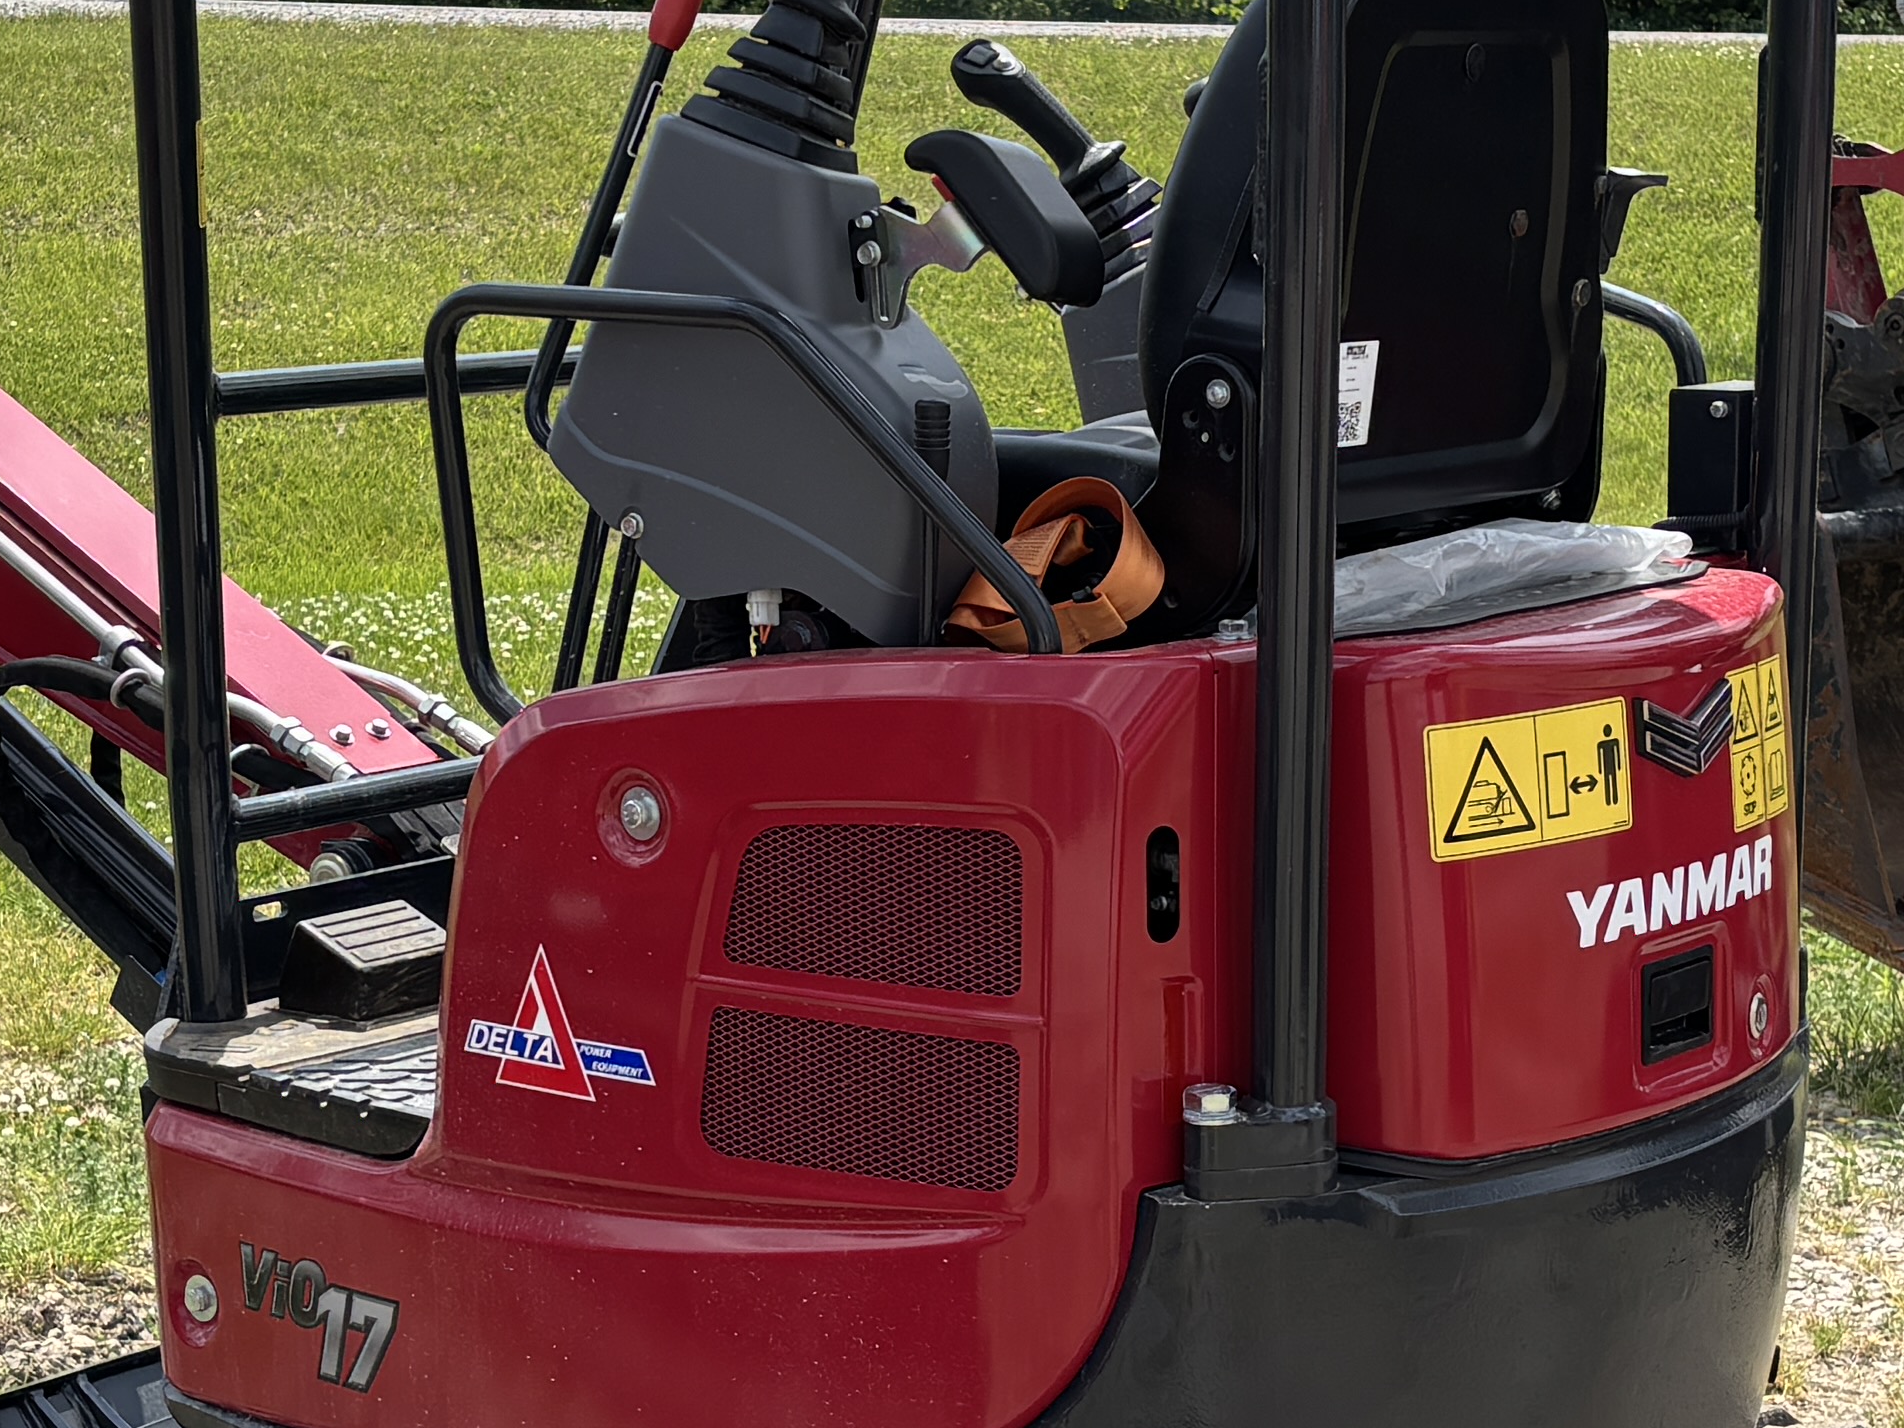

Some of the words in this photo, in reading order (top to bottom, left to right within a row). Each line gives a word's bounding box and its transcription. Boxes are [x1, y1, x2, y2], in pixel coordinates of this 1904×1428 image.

[1566, 834, 1773, 948] YANMAR
[470, 1024, 553, 1063] DELTA
[579, 1045, 612, 1059] POWER
[591, 1061, 644, 1078] EQUIPMENT
